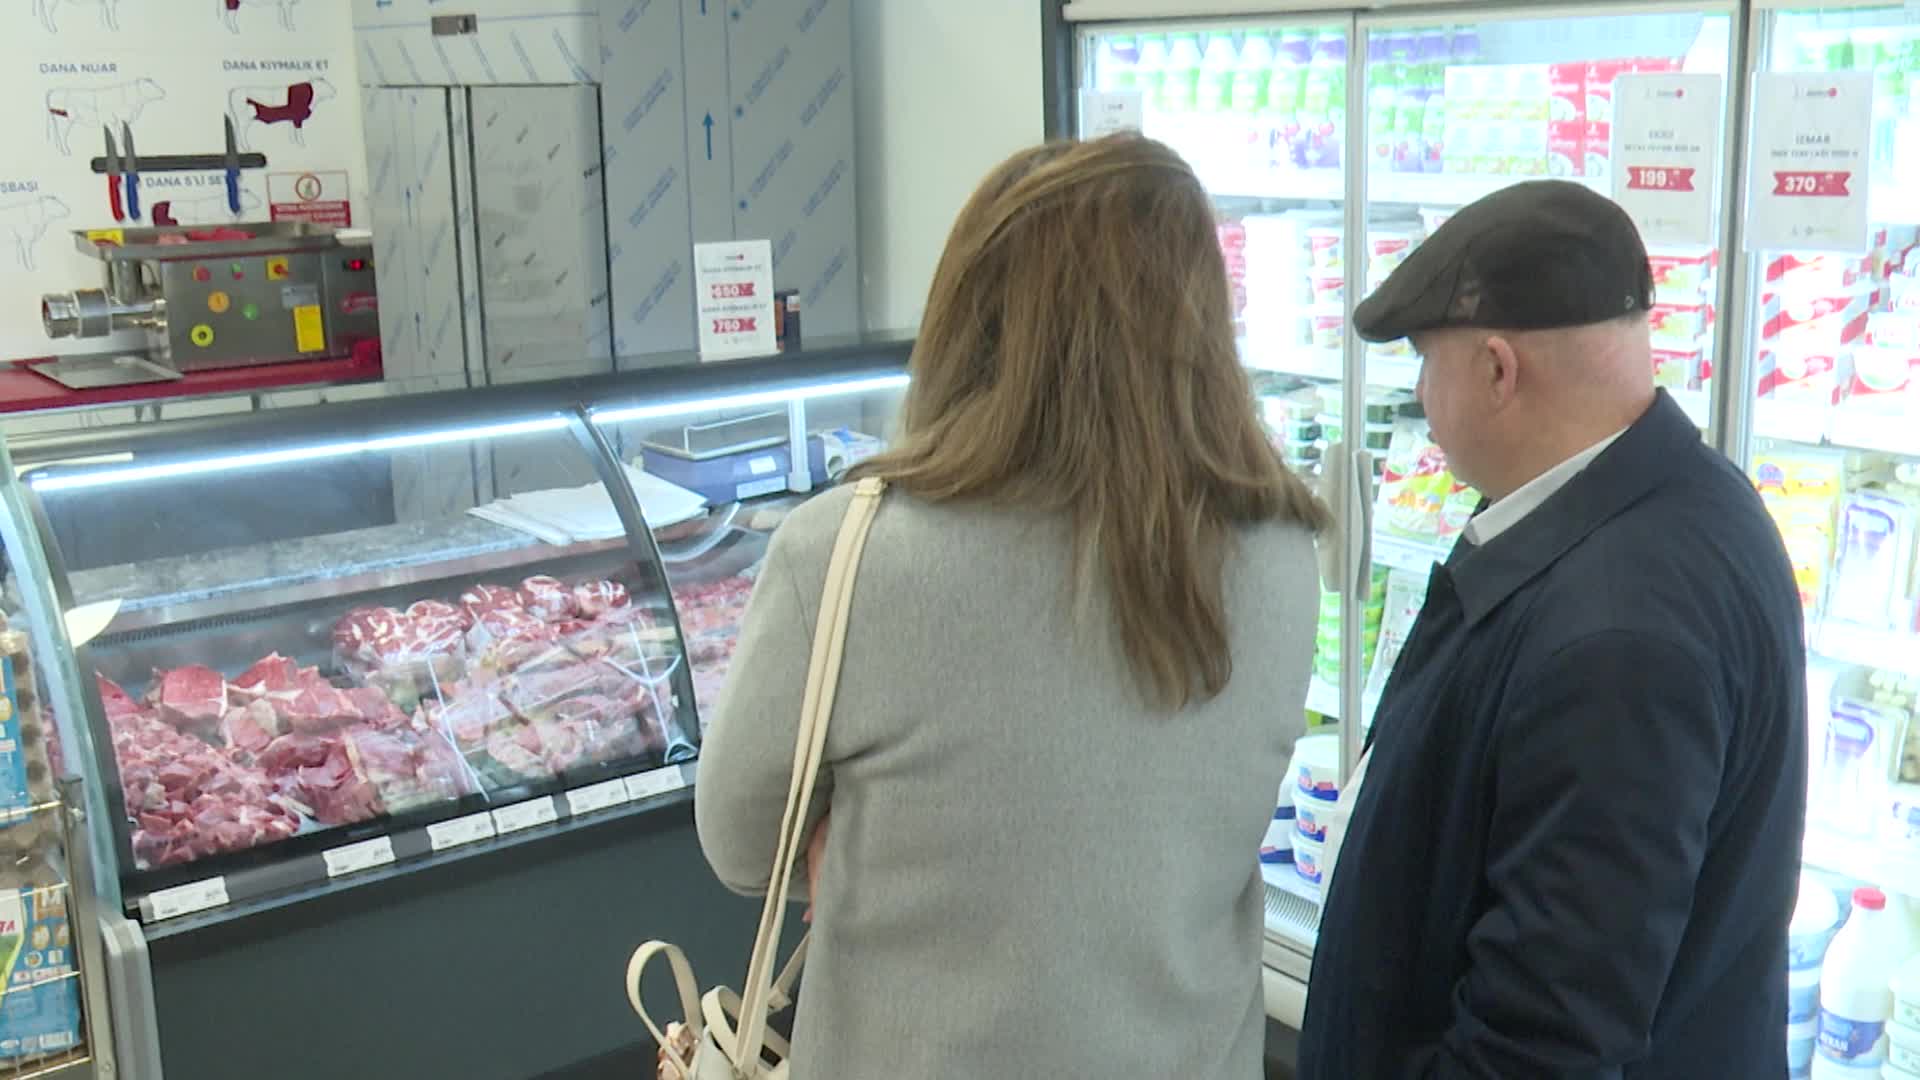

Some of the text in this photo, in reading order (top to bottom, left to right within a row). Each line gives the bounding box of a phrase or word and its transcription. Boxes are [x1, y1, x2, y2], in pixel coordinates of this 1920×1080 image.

[39, 62, 118, 74] DANA NUAR
[222, 60, 257, 71] DANA
[146, 177, 181, 189] DANA
